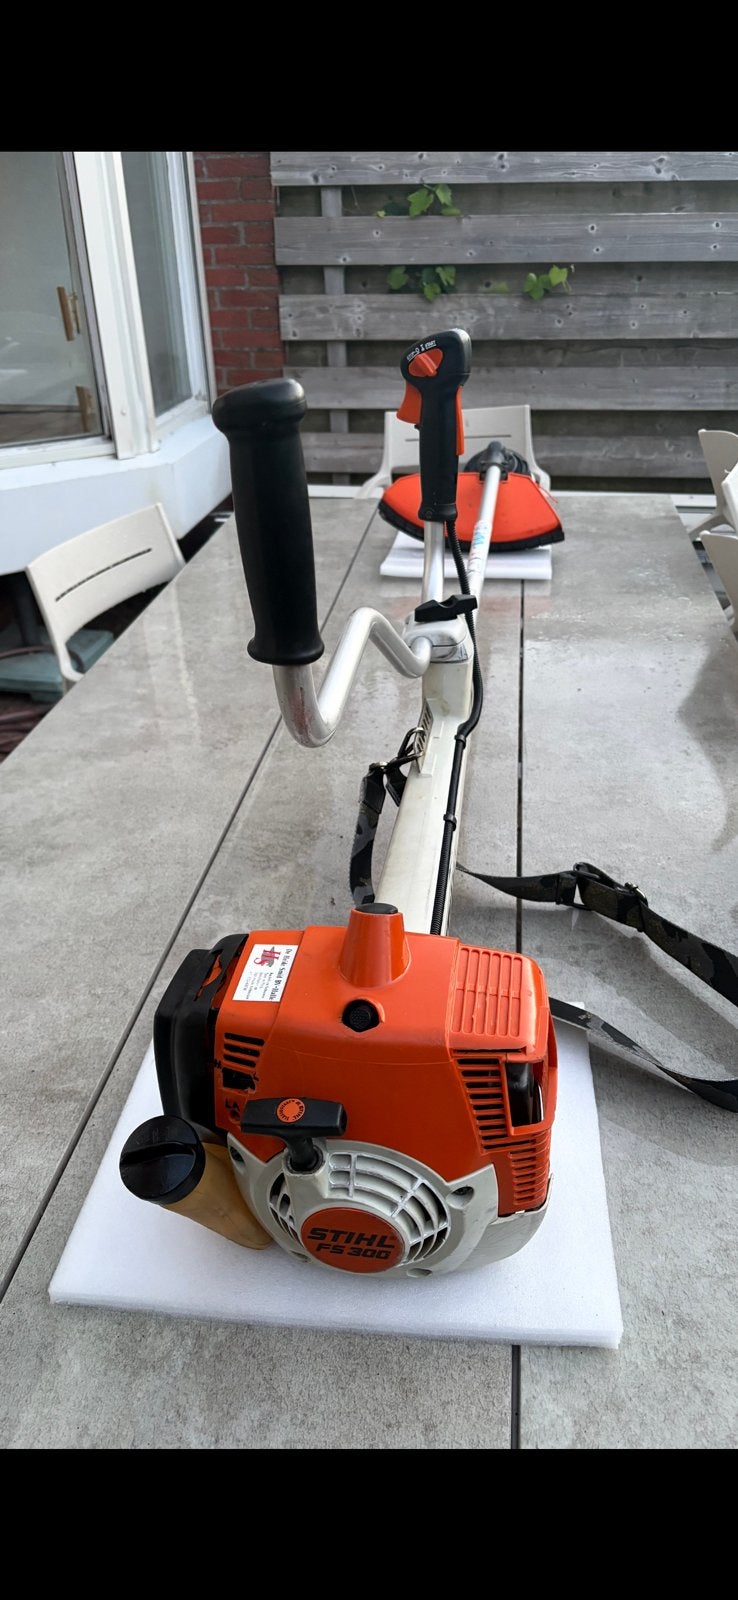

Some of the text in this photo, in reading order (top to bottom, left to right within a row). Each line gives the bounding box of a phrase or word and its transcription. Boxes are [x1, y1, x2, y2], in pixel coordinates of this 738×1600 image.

[307, 1227, 395, 1249] STIHL
[316, 1243, 391, 1260] FS 300
